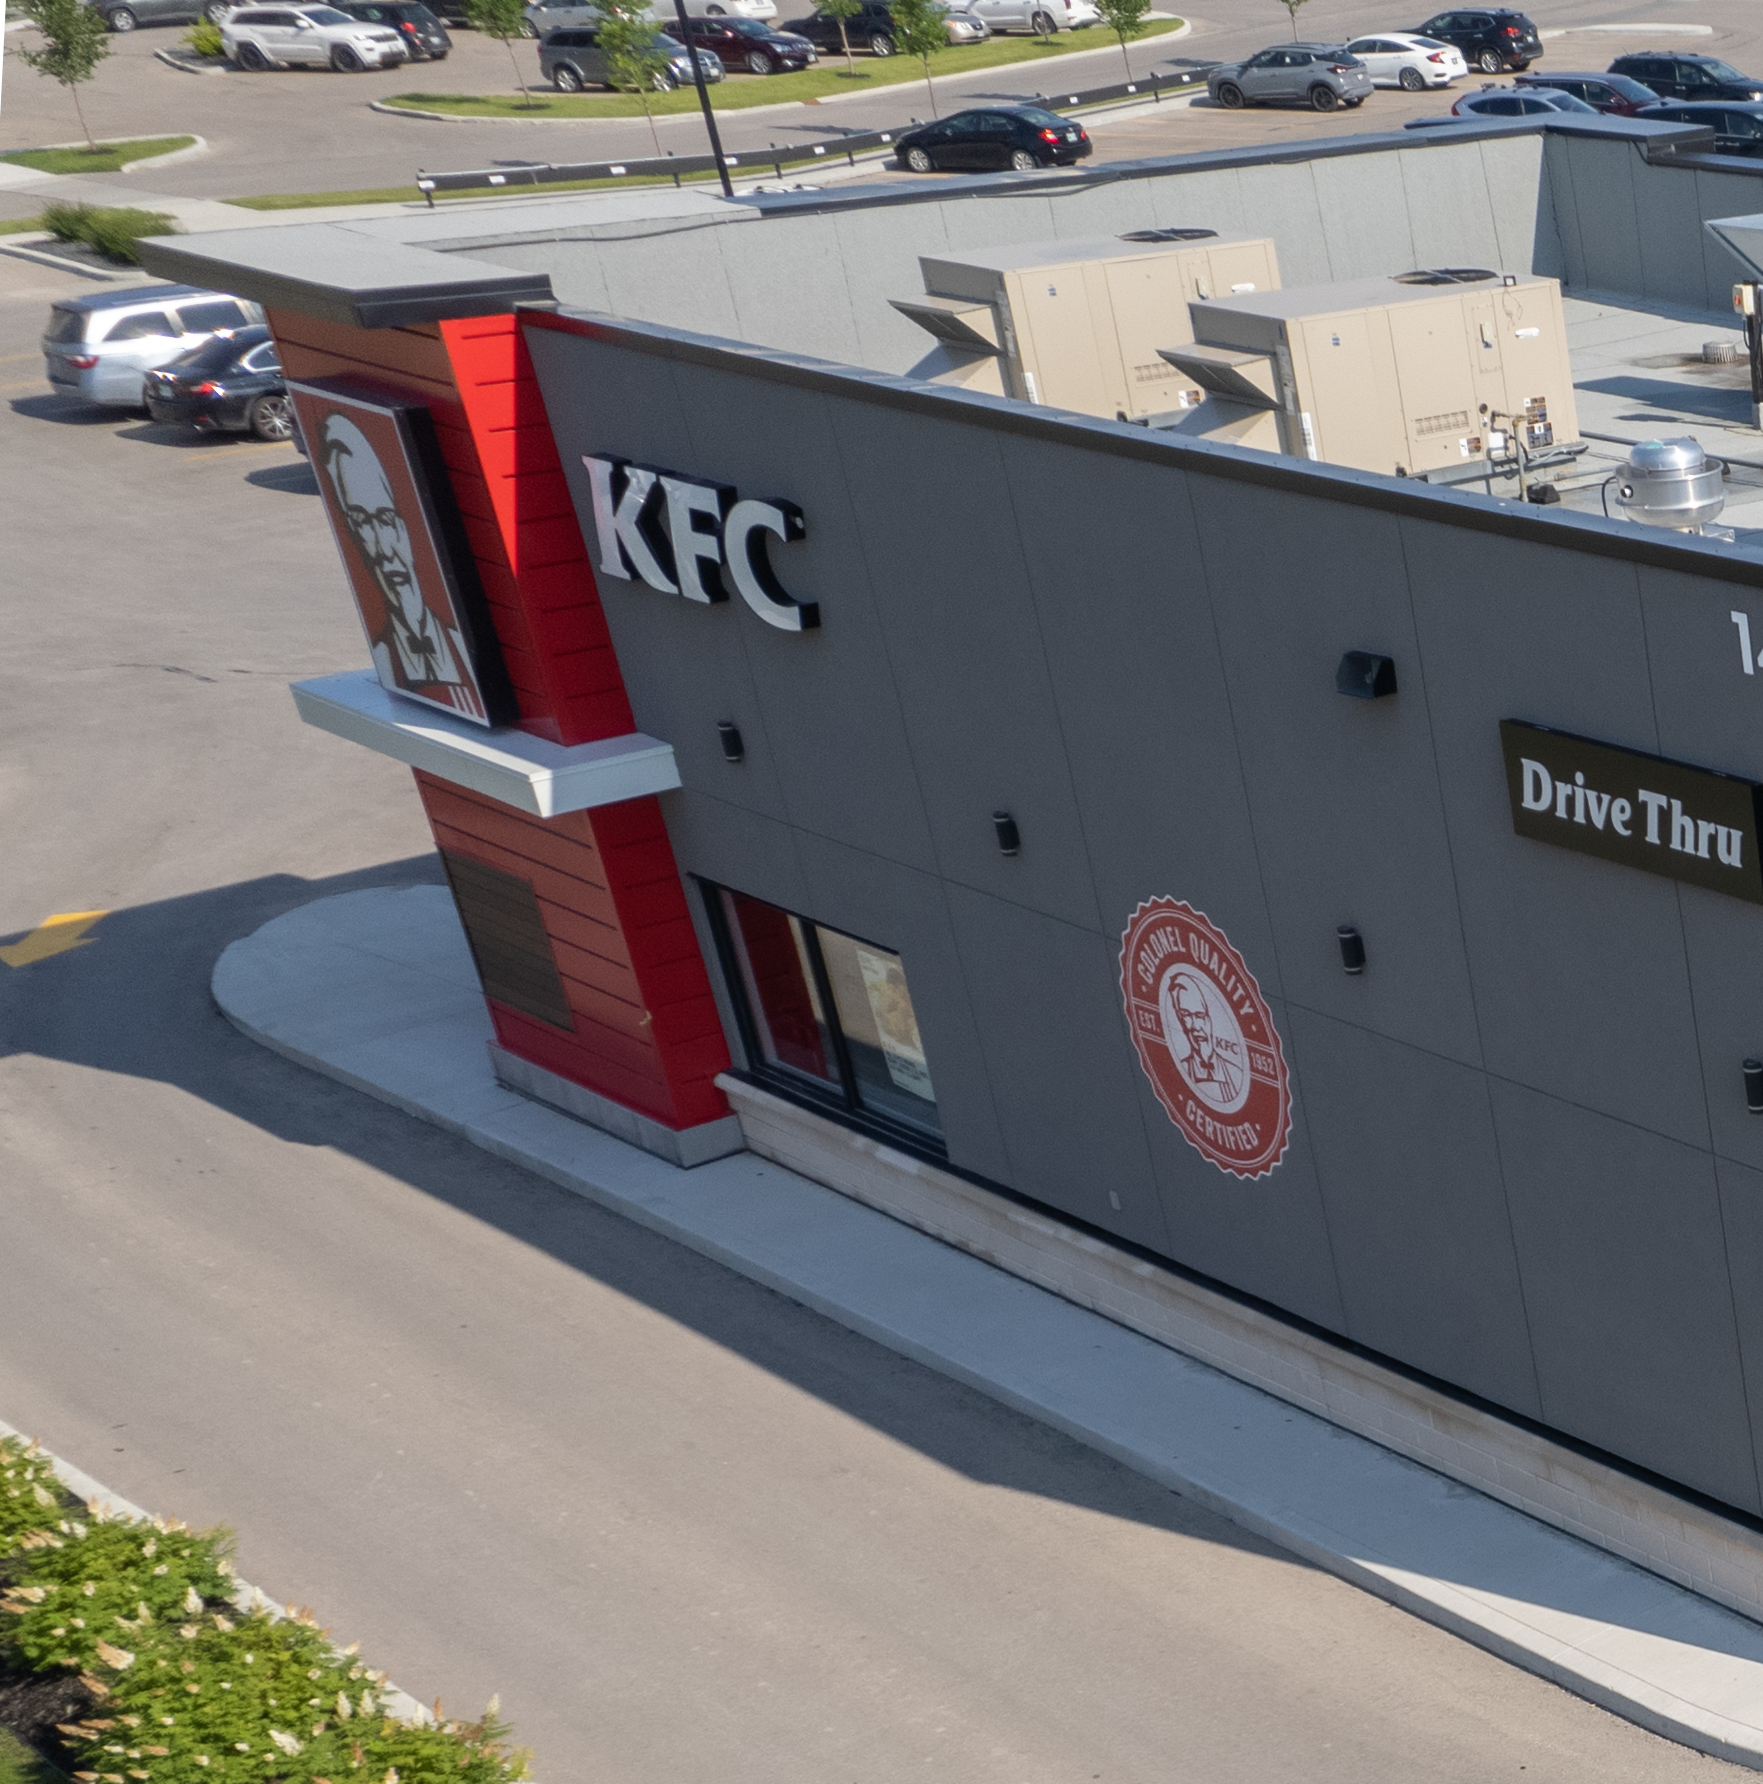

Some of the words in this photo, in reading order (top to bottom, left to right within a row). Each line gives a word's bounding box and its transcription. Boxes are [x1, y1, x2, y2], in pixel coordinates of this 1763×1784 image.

[582, 455, 806, 632] KFC
[1519, 758, 1632, 836] Drive
[1638, 789, 1743, 869] Thru
[1138, 926, 1186, 984] COLONEL
[1189, 932, 1254, 1016] QUALITY
[1138, 1010, 1161, 1033] EST.
[1215, 1035, 1239, 1056] KFC
[1251, 1051, 1276, 1076] 1952
[1186, 1100, 1259, 1151] CERTIFIED
